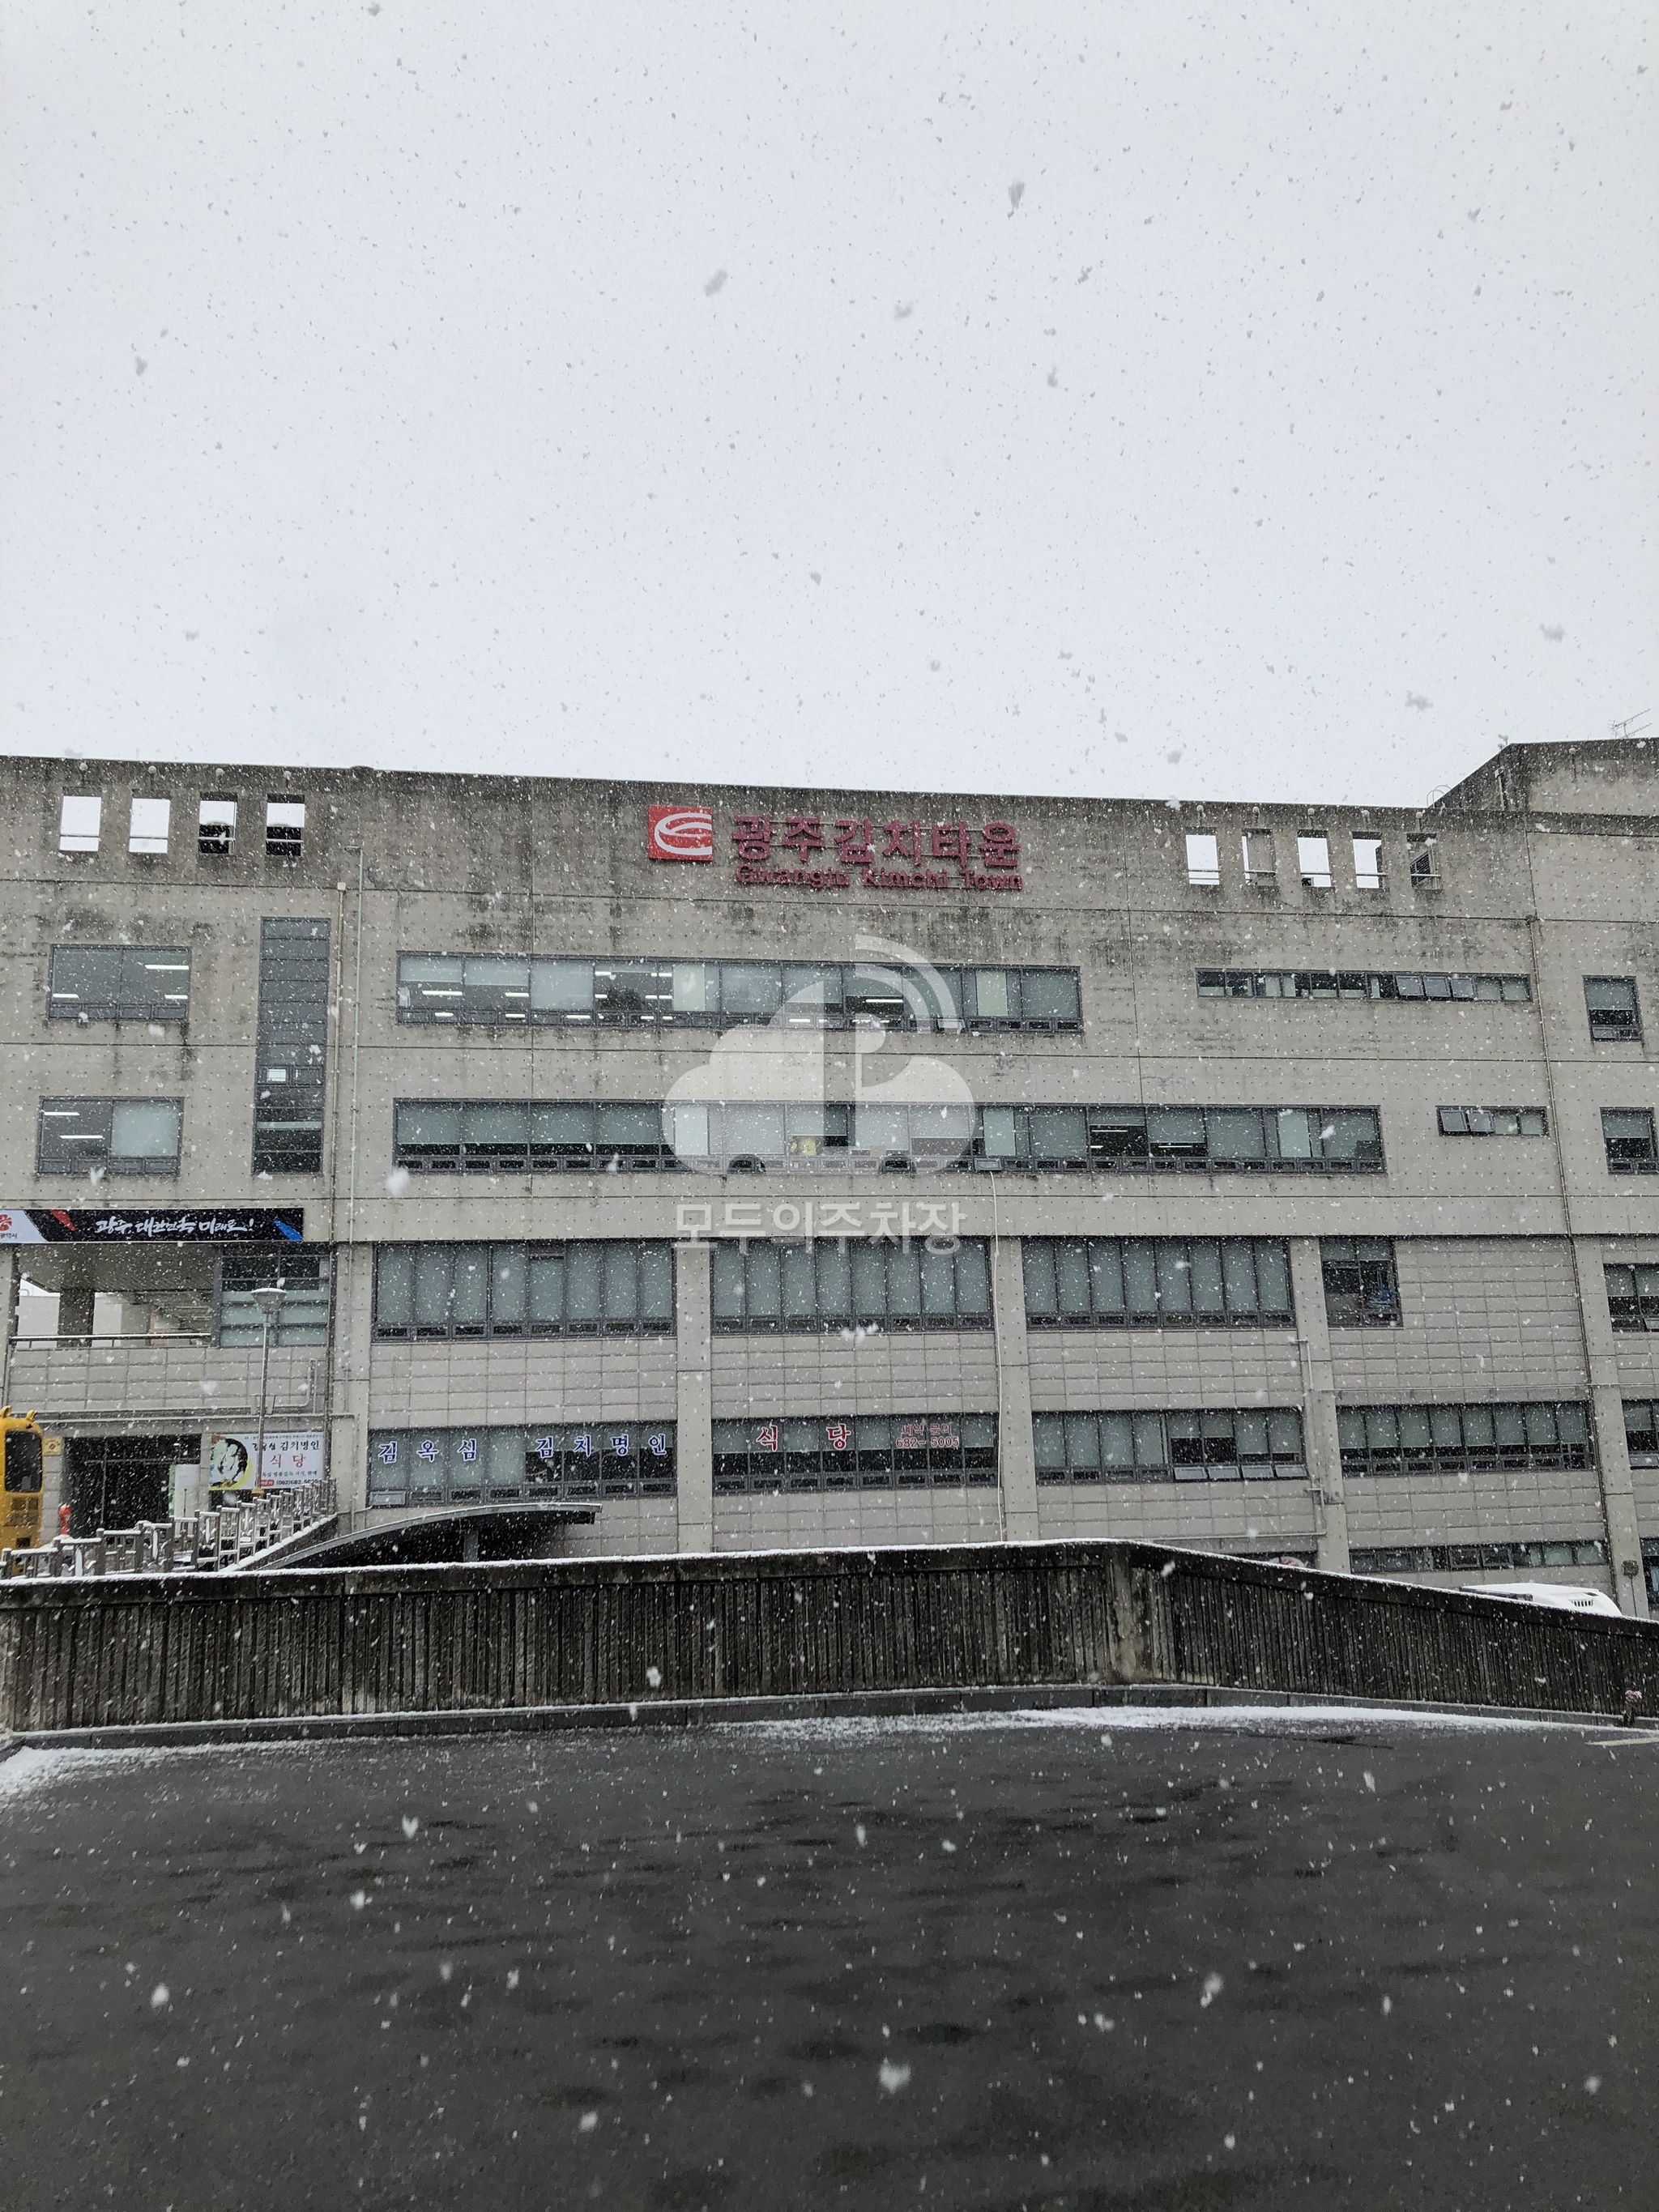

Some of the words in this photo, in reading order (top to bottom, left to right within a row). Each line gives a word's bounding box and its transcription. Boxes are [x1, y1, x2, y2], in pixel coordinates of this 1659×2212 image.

[731, 814, 1021, 867] 광주김치타운
[736, 863, 851, 889] Gwangju
[861, 867, 949, 890] Kimchi
[961, 869, 1023, 892] Town
[135, 1216, 197, 1238] 대한민국
[902, 1423, 925, 1436] 예약
